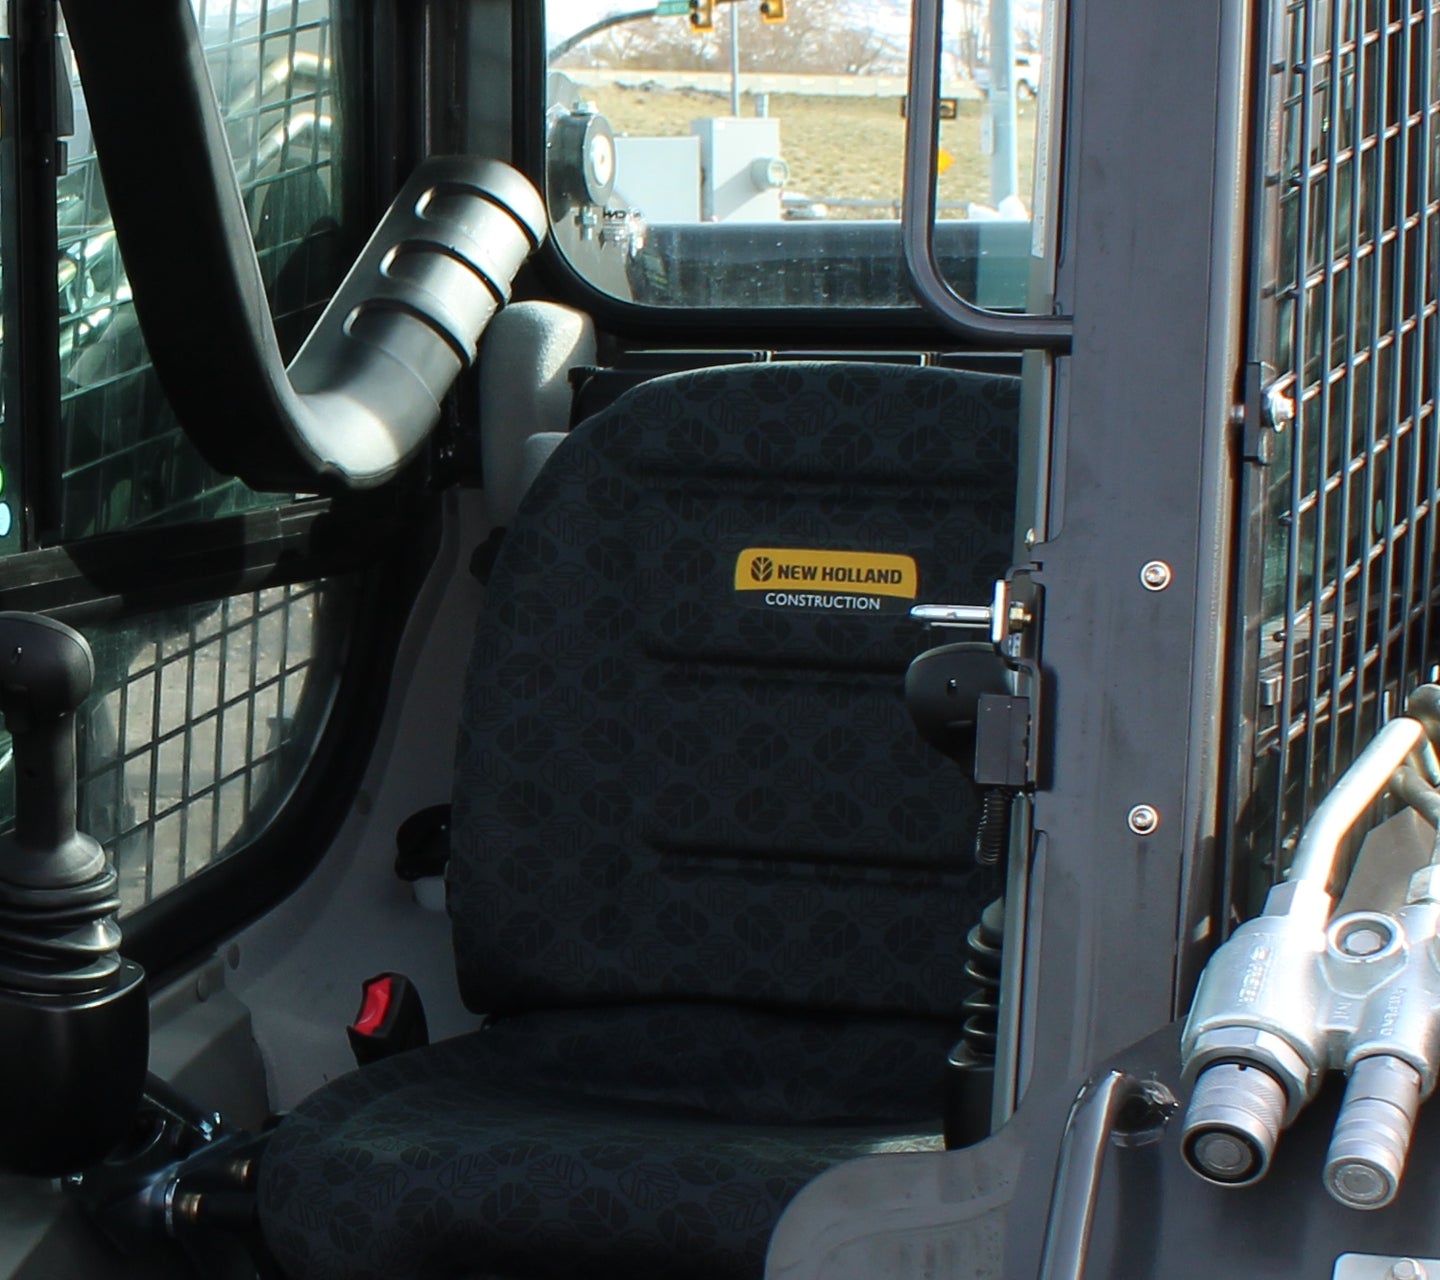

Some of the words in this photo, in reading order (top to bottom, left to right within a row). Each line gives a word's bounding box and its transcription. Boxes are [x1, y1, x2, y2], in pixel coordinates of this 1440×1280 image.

[777, 564, 818, 581] NEW
[821, 566, 902, 585] HOLLAND
[765, 592, 881, 610] CONSTRUCTION
